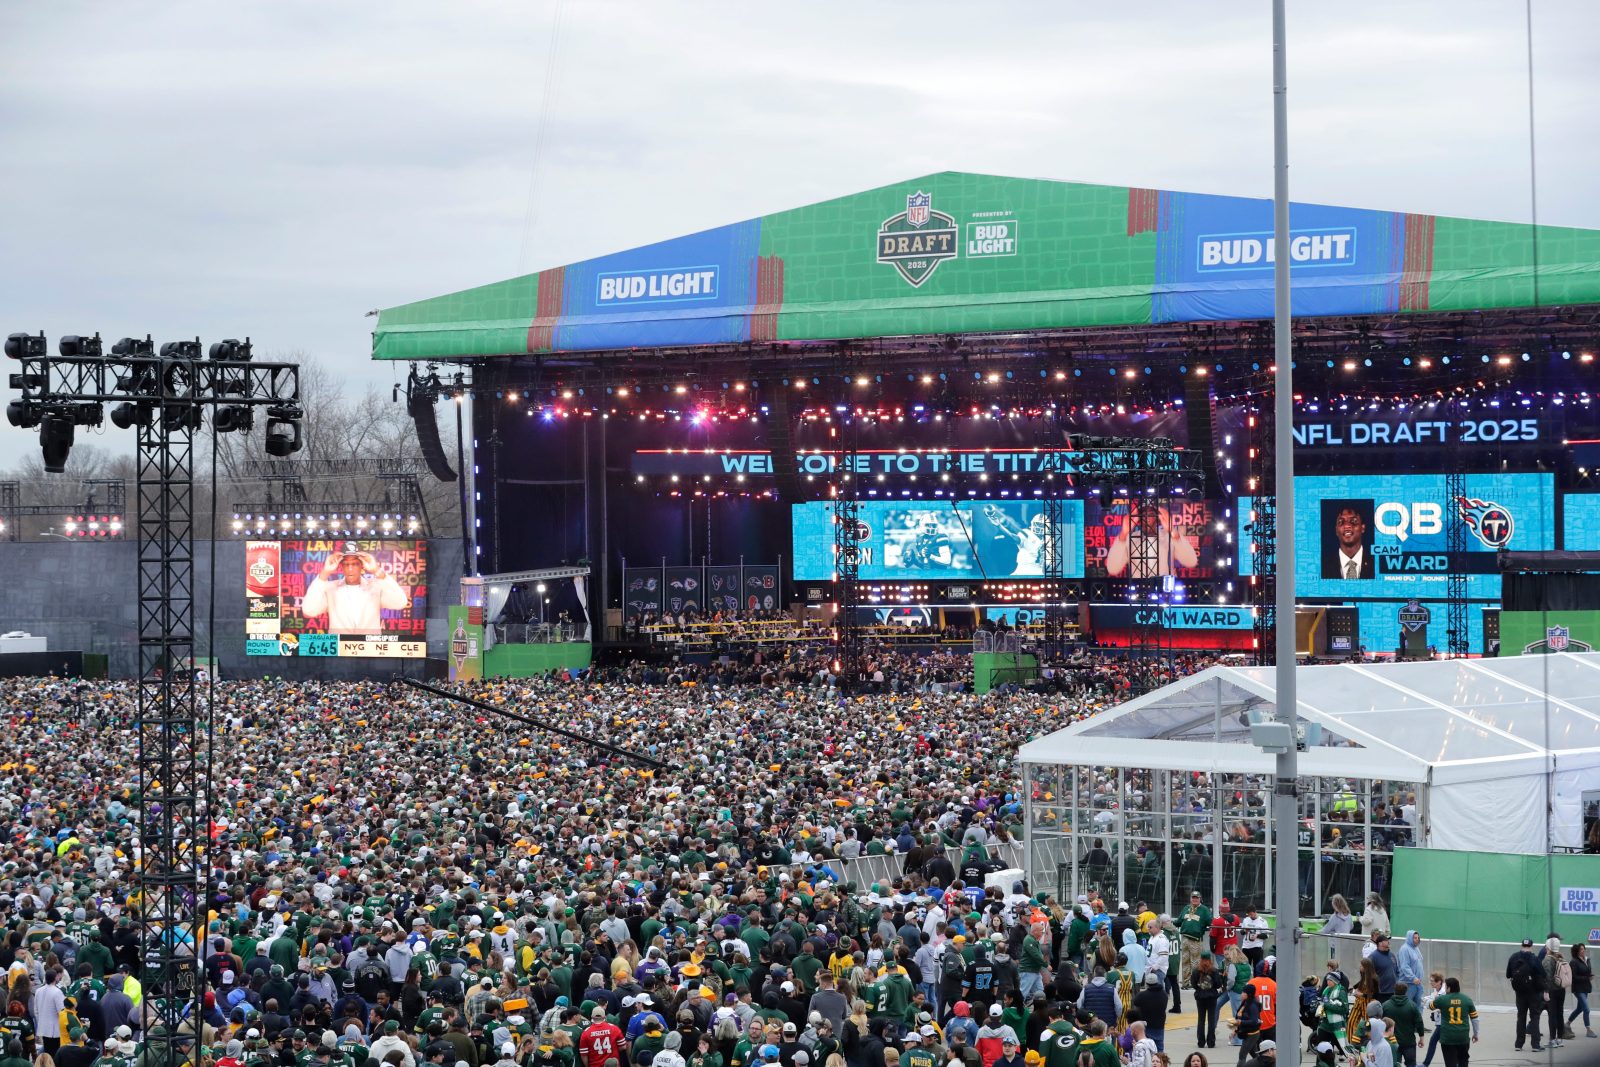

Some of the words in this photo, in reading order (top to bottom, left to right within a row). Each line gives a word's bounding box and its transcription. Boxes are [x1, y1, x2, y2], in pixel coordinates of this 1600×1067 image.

[910, 206, 927, 222] NFL
[975, 225, 1008, 240] BUD
[883, 234, 952, 254] DRAFT
[969, 238, 1014, 254] LIGHT
[1202, 239, 1262, 266] BUD
[1266, 234, 1350, 262] LGHT
[907, 261, 927, 269] 2025
[600, 276, 646, 300] BUD
[648, 271, 715, 297] LIGHT
[1293, 424, 1342, 445] NFL
[1351, 422, 1451, 443] DRAFT
[1459, 419, 1538, 442] 2025
[878, 454, 920, 473] TO
[927, 454, 985, 472] THE
[1183, 503, 1211, 514] NFL
[1172, 514, 1212, 526] DRAF
[1374, 502, 1443, 542] QB
[393, 551, 425, 561] NFL
[1373, 546, 1399, 554] CAM
[1386, 556, 1448, 571] WARD
[1135, 610, 1177, 625] CAM
[1183, 610, 1241, 625] WARD
[308, 642, 338, 655] 6:45
[1550, 637, 1565, 647] NFL
[1299, 831, 1310, 844] 15
[658, 861, 665, 870] 7
[1567, 890, 1593, 901] BUD
[1561, 900, 1598, 912] LIGHT
[1223, 928, 1235, 939] 13
[501, 937, 508, 951] 4
[425, 959, 437, 976] 10
[975, 973, 992, 990] 97
[1448, 1007, 1463, 1024] 11
[593, 1036, 612, 1055] 44
[1057, 1034, 1075, 1048] G
